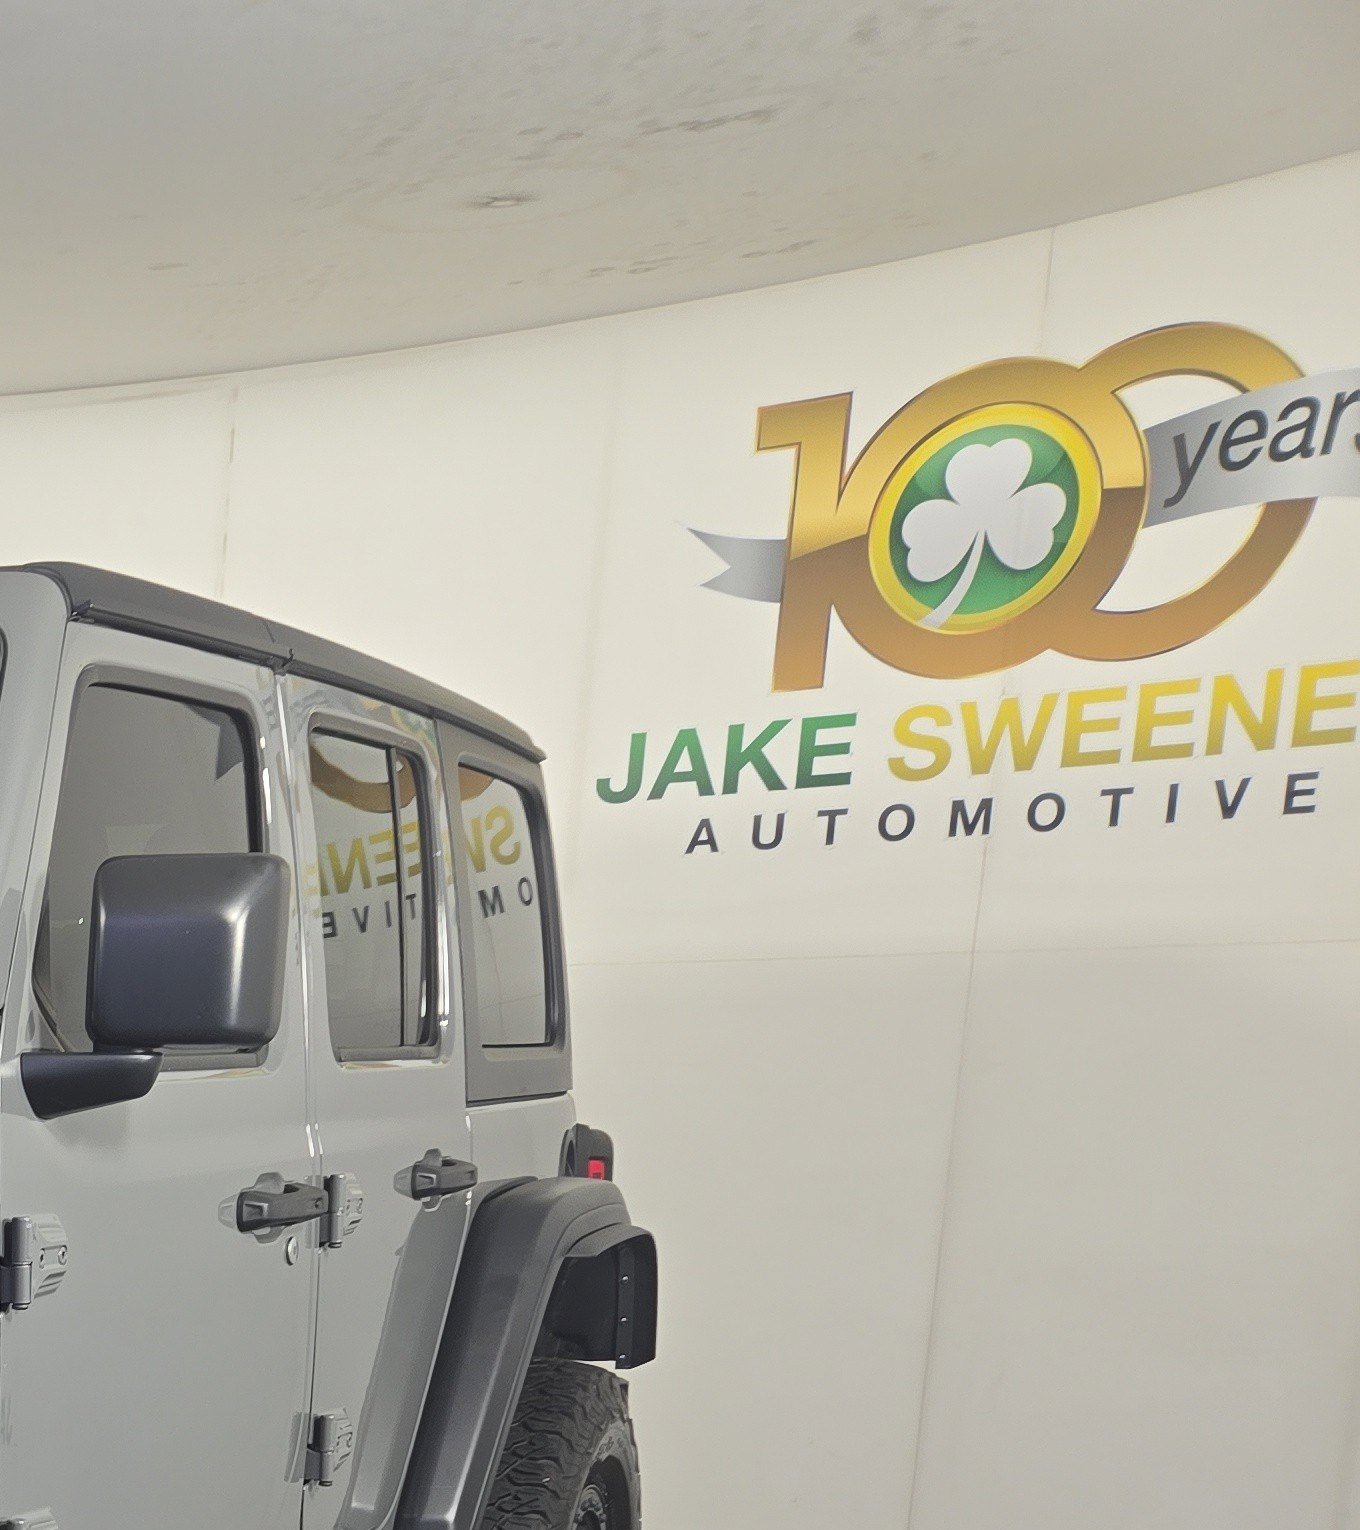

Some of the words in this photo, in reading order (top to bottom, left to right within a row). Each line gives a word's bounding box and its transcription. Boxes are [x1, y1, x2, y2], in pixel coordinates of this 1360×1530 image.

[754, 321, 1316, 693] 100
[1164, 386, 1360, 507] year
[596, 713, 857, 804] JAKE
[888, 659, 1360, 783] SWEENE
[683, 771, 1321, 855] AUTOMOTIVE
